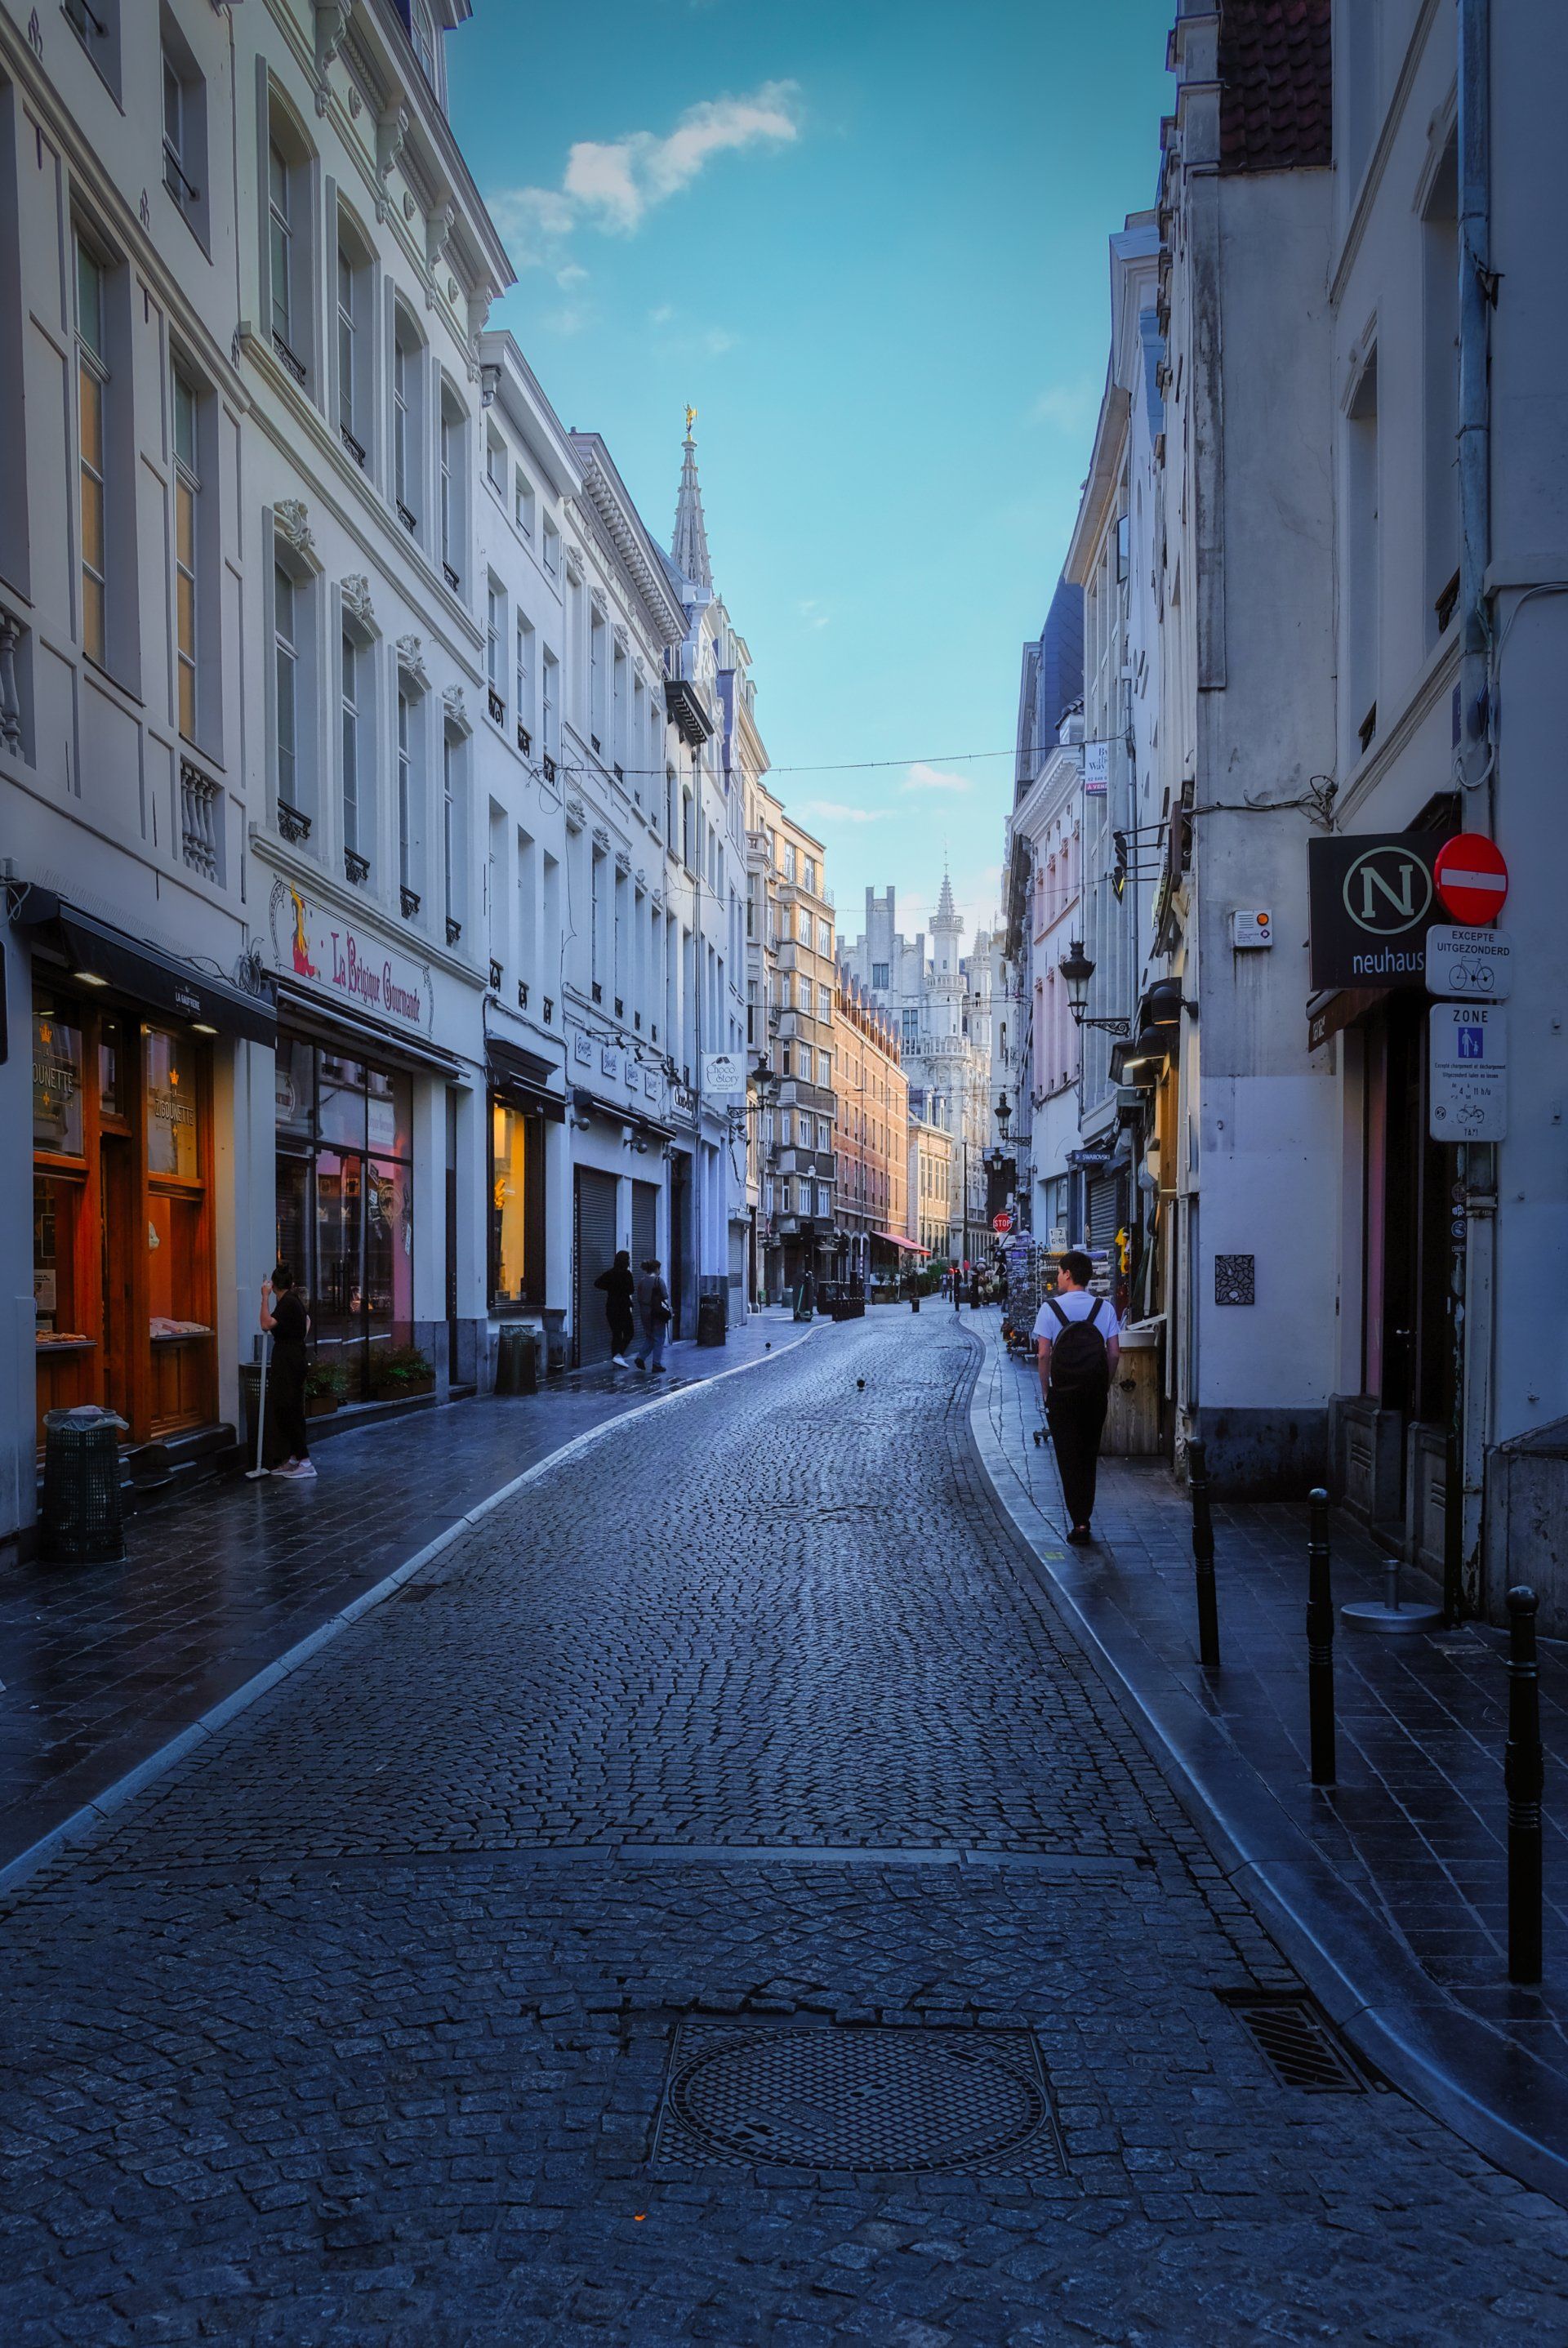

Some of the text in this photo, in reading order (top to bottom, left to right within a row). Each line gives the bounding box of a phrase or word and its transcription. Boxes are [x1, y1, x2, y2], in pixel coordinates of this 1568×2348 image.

[1089, 762, 1104, 773] Way
[1360, 864, 1414, 918] N
[1452, 930, 1494, 942] EXCEPTE
[1437, 942, 1510, 956] UITGEZONDERD
[1352, 945, 1425, 974] neuhaus
[331, 929, 421, 1023] La Belgique Gourmande
[1453, 1009, 1489, 1023] ZONE
[706, 1064, 736, 1074] Choco
[33, 1062, 74, 1094] OUNETTE
[715, 1074, 739, 1085] Story
[154, 1098, 194, 1126] ZIGOUNETTE
[994, 1219, 1011, 1227] STOP
